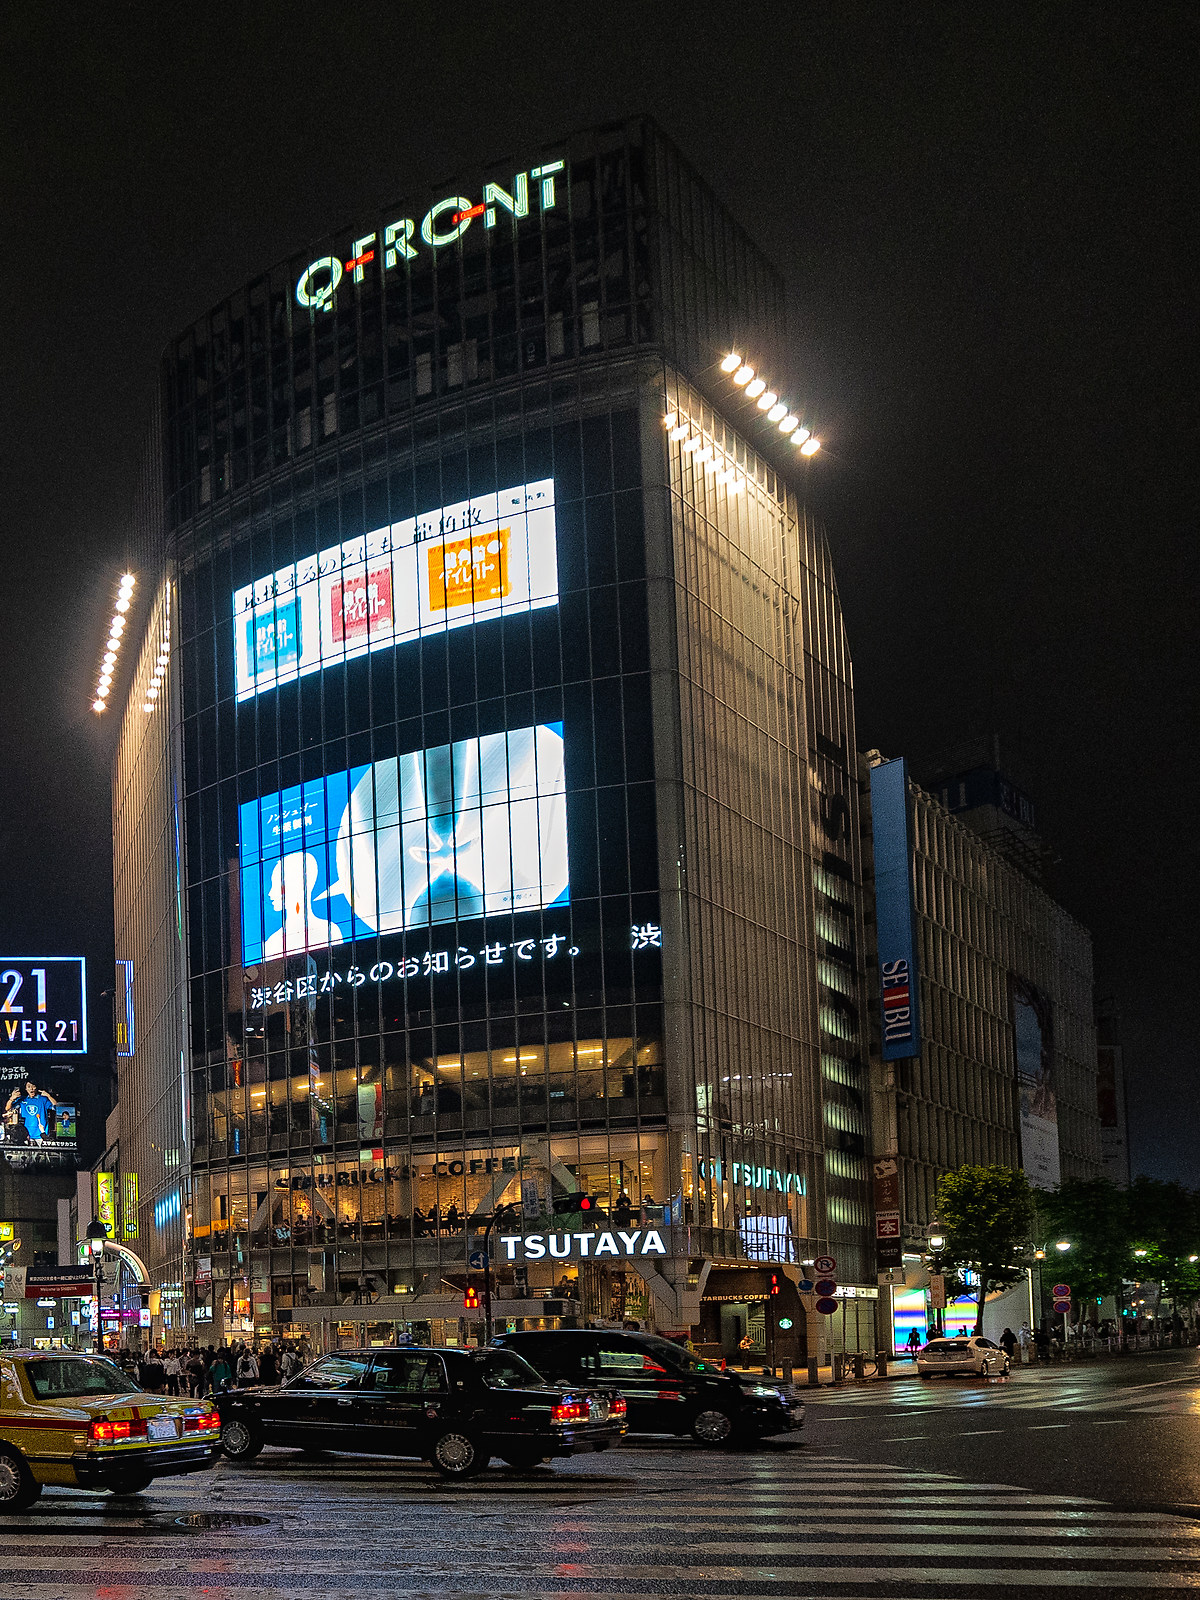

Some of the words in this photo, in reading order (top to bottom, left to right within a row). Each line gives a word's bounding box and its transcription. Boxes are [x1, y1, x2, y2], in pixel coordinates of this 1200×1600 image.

[296, 159, 564, 312] QFRONT
[250, 932, 581, 1009] 渋谷区からのお知らせです。
[881, 958, 911, 1042] SEIBU
[55, 1020, 78, 1042] 21
[500, 1229, 667, 1260] TSUTAYA
